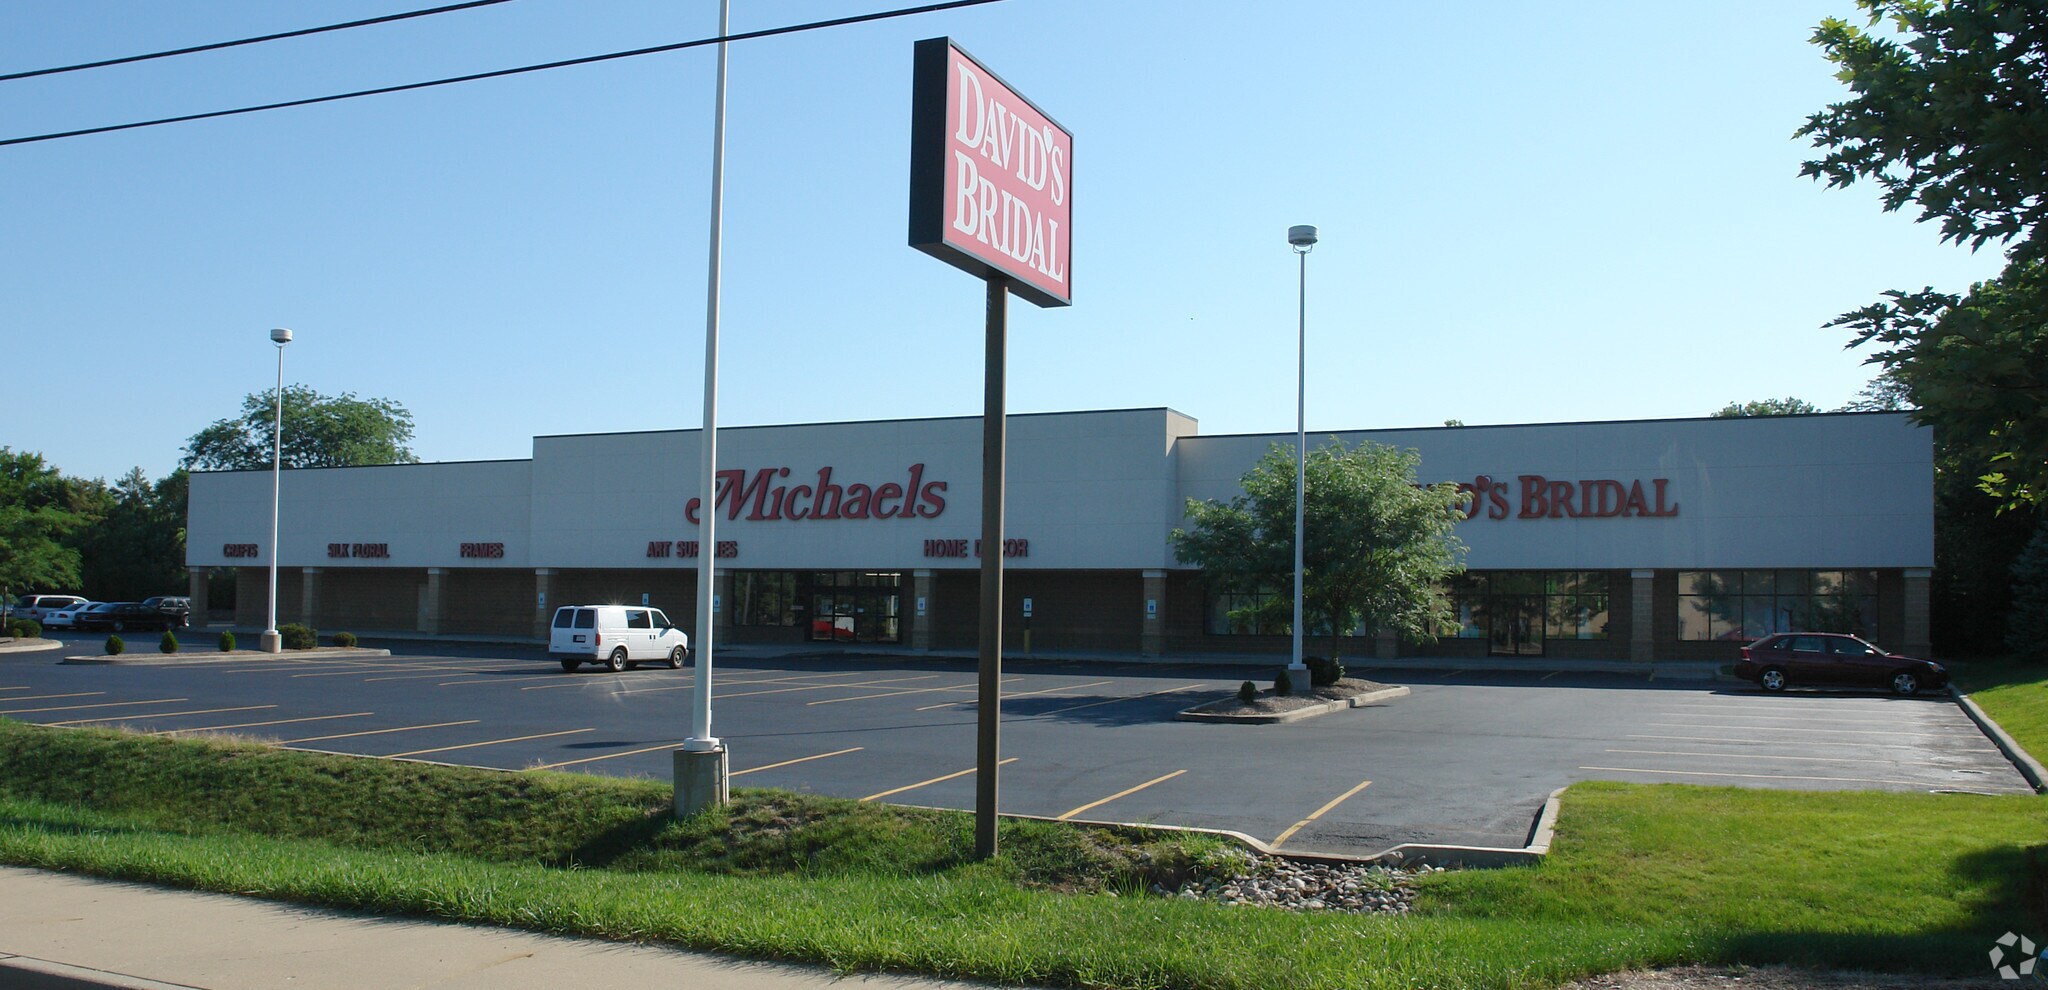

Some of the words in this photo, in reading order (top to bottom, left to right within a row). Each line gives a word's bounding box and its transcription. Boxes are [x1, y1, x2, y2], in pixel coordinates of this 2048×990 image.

[955, 61, 1064, 207] DAVID'S
[953, 149, 1063, 283] BRIDAL
[684, 463, 948, 525] Michaels
[1517, 475, 1679, 520] BRIDAL
[223, 543, 258, 558] CRAFTS
[327, 542, 350, 558] SILK
[352, 542, 390, 558] FLORAL
[460, 542, 504, 559] FRAMES
[646, 541, 672, 558] ART
[923, 539, 968, 558] HOME
